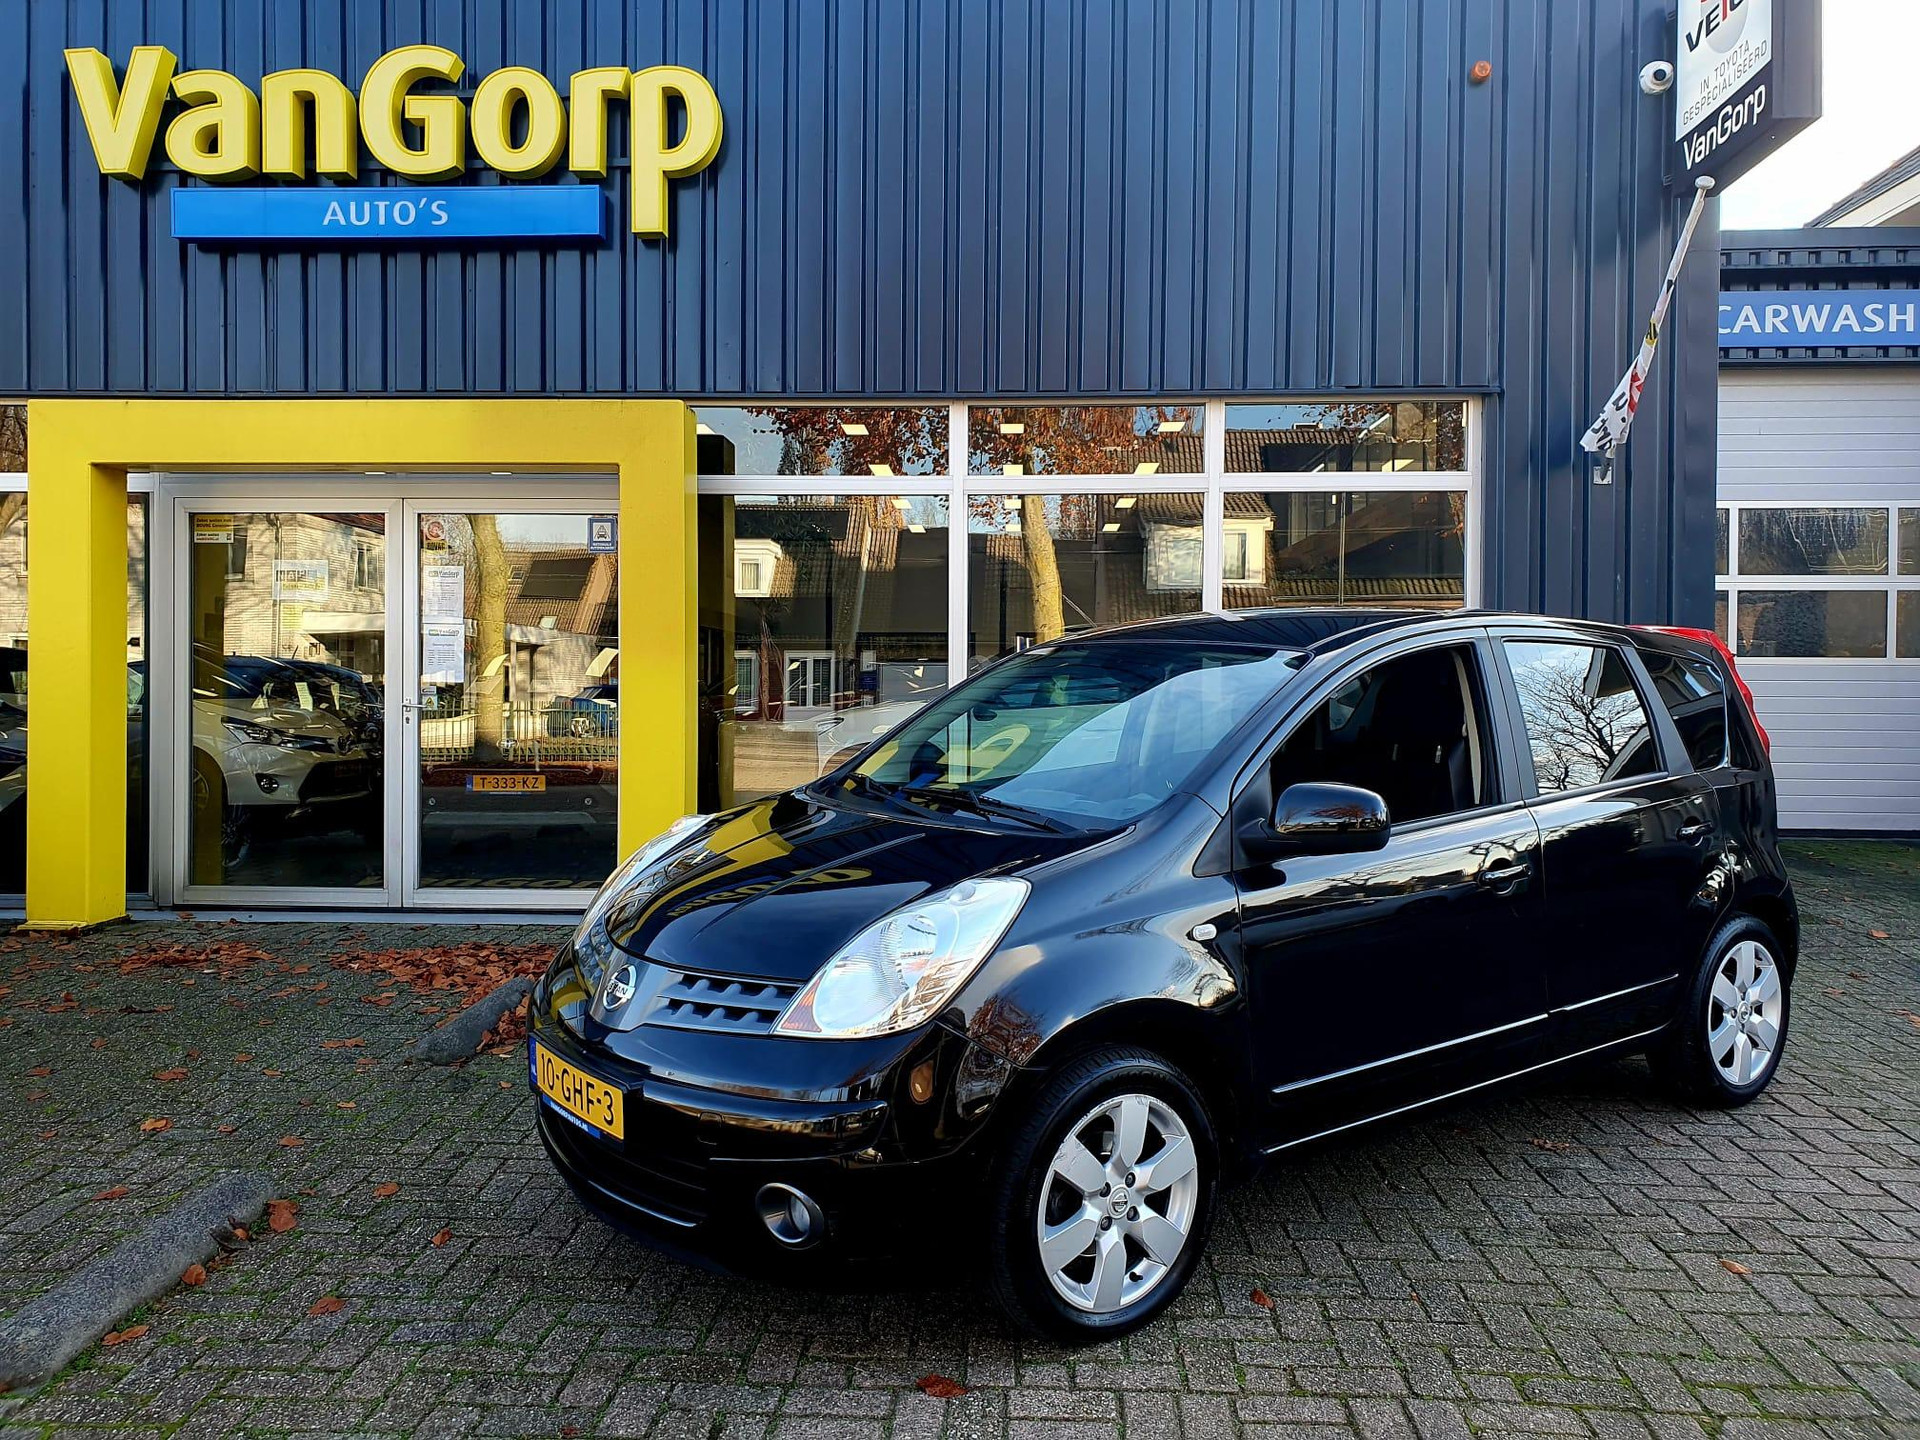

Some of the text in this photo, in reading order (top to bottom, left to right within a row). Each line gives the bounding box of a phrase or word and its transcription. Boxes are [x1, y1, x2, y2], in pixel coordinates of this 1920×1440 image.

[1683, 39, 1767, 126] GESPECIALISEERD
[1700, 39, 1750, 94] IN TOYOTA
[64, 44, 722, 238] VanGorp
[1683, 83, 1766, 171] VanGorp
[322, 197, 448, 226] AUTO'S
[1719, 303, 1914, 334] CARWASH
[479, 776, 540, 789] T-333-KZ
[541, 1052, 614, 1126] 10-GHF-3
